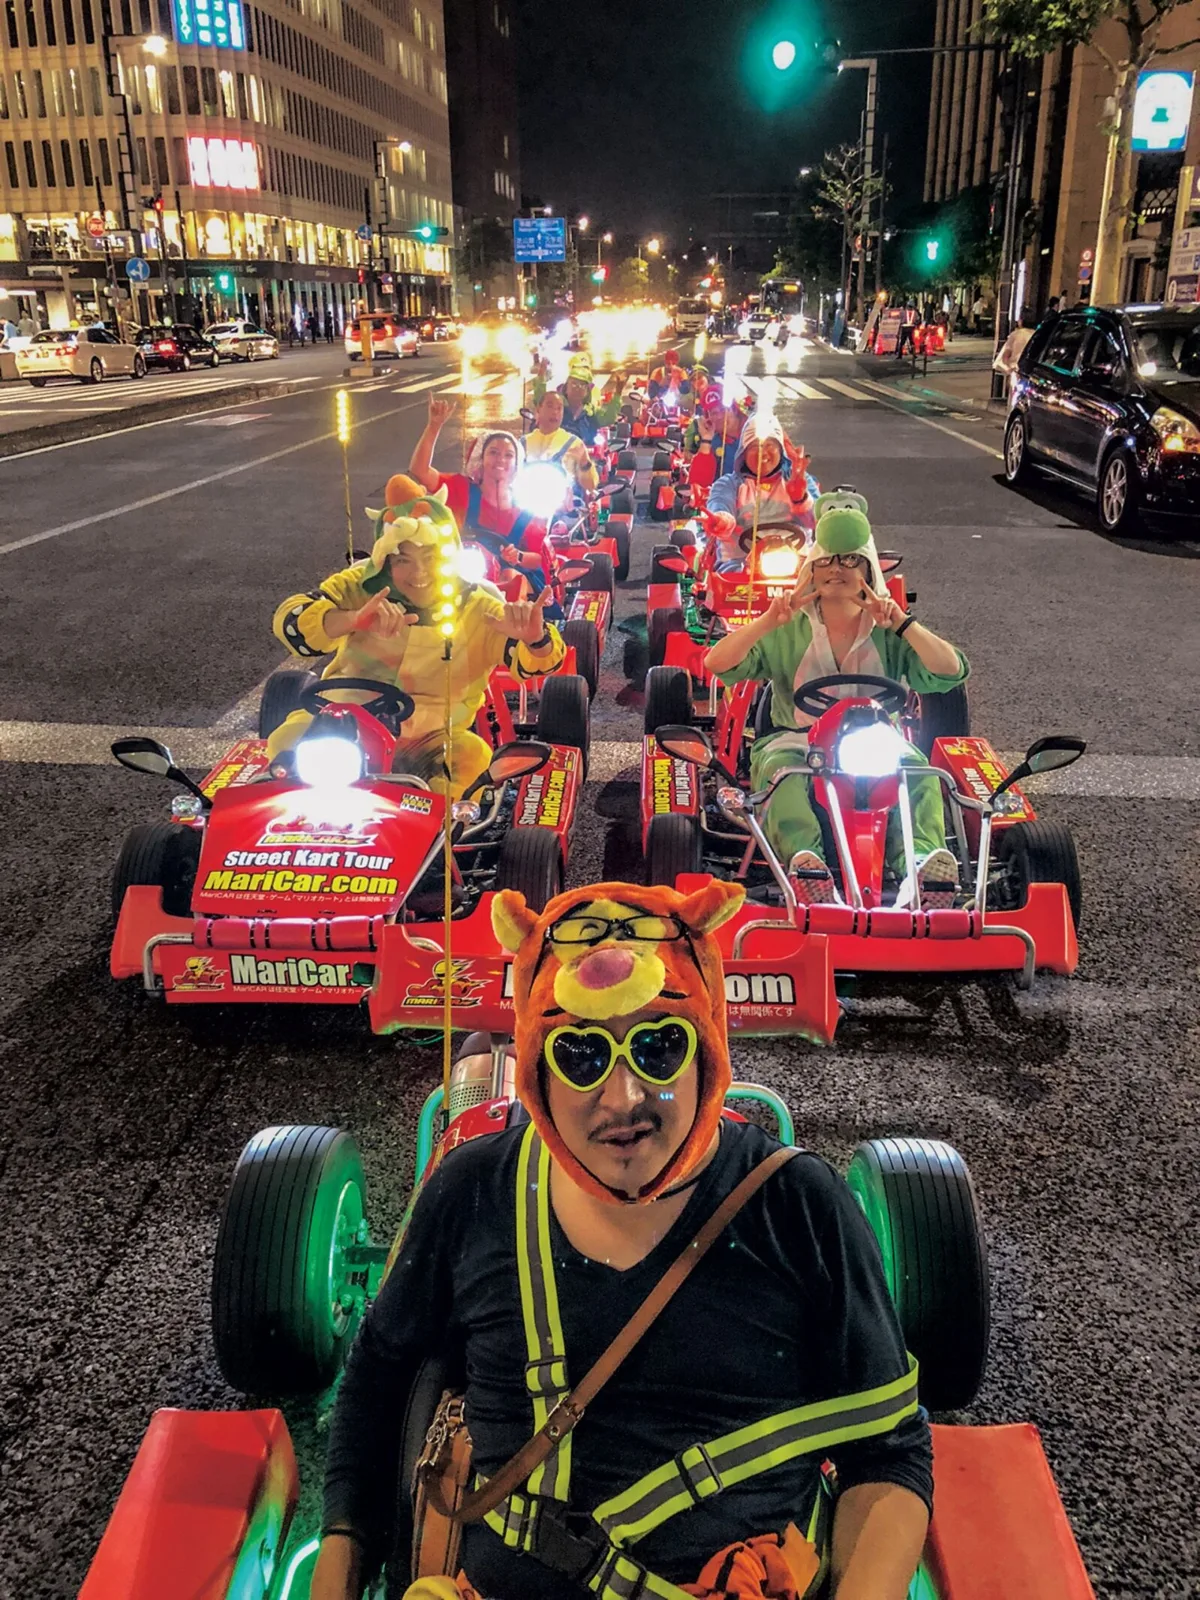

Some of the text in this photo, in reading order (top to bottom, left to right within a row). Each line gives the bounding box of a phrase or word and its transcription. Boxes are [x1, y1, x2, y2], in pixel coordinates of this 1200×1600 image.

[518, 774, 544, 825] Street Kart Tour
[538, 770, 567, 827] MariCar.com
[654, 758, 672, 814] MariCar.com
[202, 869, 399, 895] MariCar.com
[223, 848, 394, 871] Street Kart Tour
